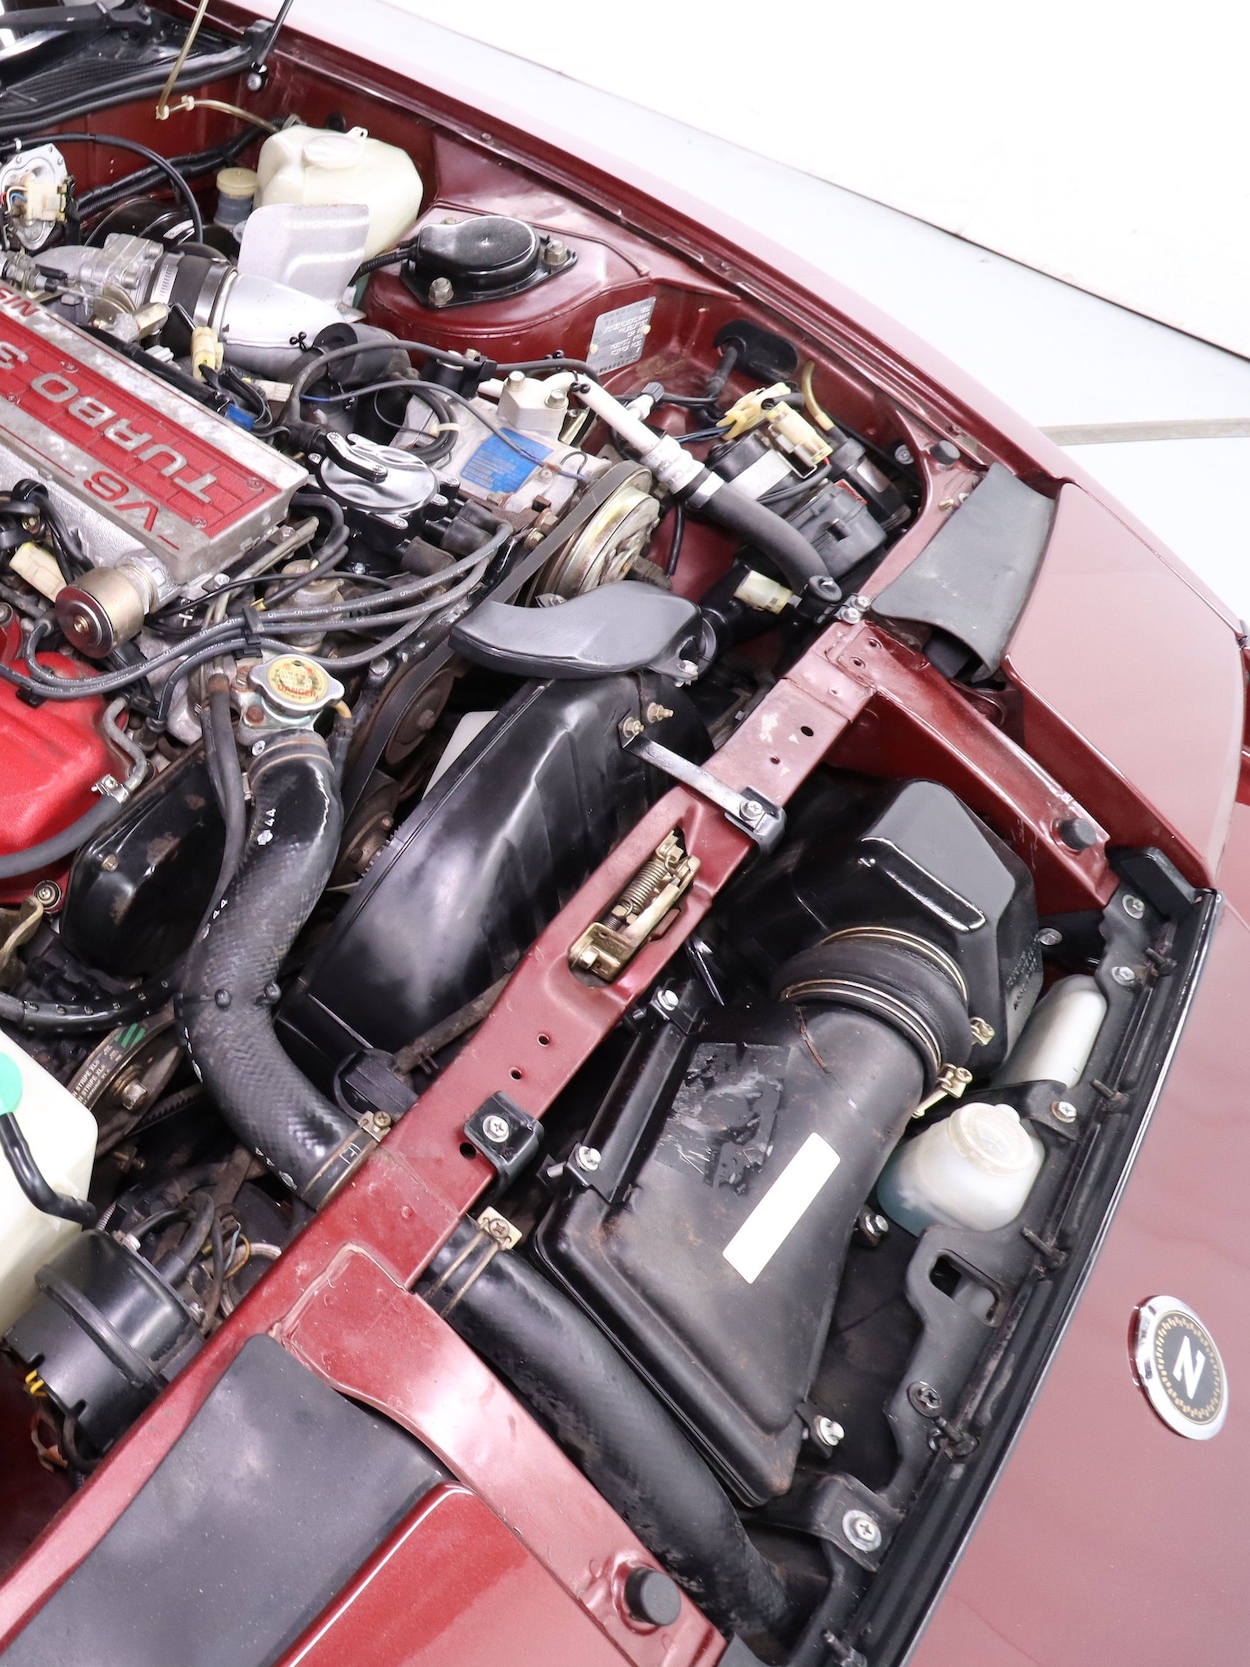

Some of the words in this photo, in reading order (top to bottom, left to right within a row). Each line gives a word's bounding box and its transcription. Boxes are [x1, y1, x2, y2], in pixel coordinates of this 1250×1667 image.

[30, 372, 217, 503] TURBO
[84, 470, 158, 532] V6
[278, 683, 316, 697] DANGER
